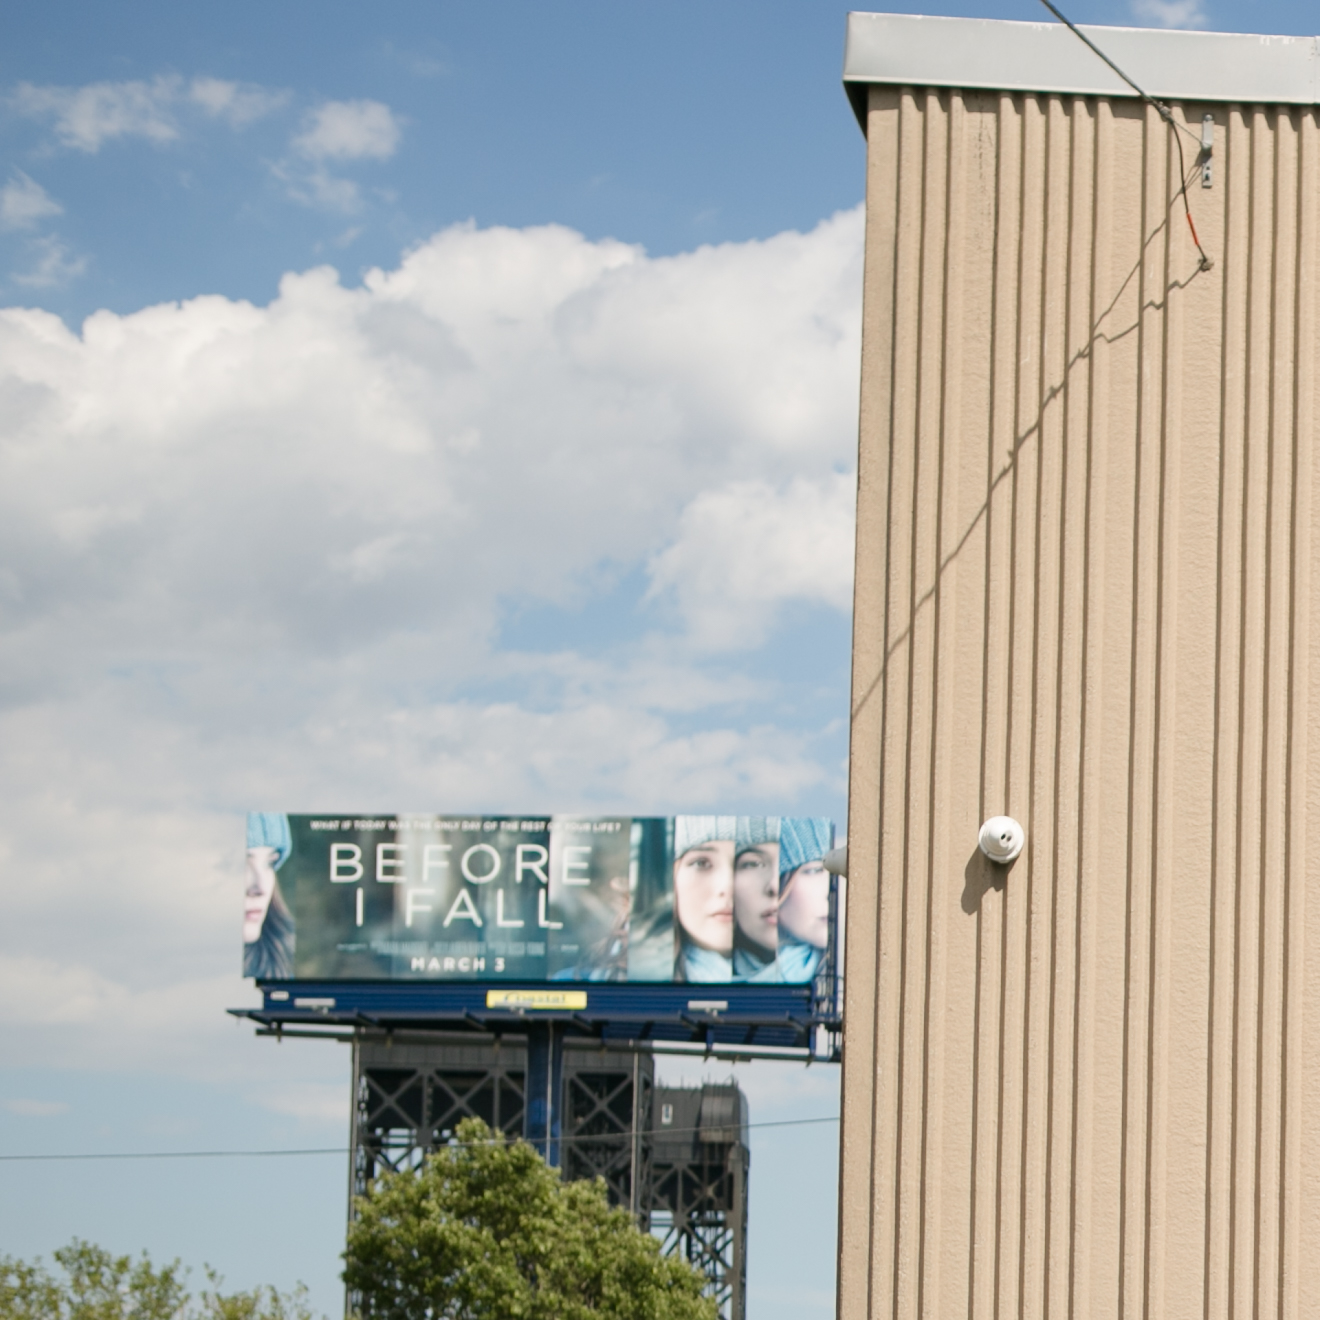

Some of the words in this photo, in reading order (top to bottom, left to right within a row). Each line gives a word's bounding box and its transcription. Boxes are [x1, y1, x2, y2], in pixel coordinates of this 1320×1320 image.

[341, 820, 352, 831] IF
[354, 820, 387, 831] TODAY
[461, 820, 482, 831] DAY
[483, 820, 498, 831] OF
[500, 821, 519, 832] THE
[520, 821, 546, 832] REST
[592, 821, 621, 833] LIFE?
[330, 842, 592, 886] BEFORE
[356, 887, 364, 927] I
[405, 887, 563, 930] FALL
[410, 956, 485, 972] MARCH
[494, 957, 506, 972] 3
